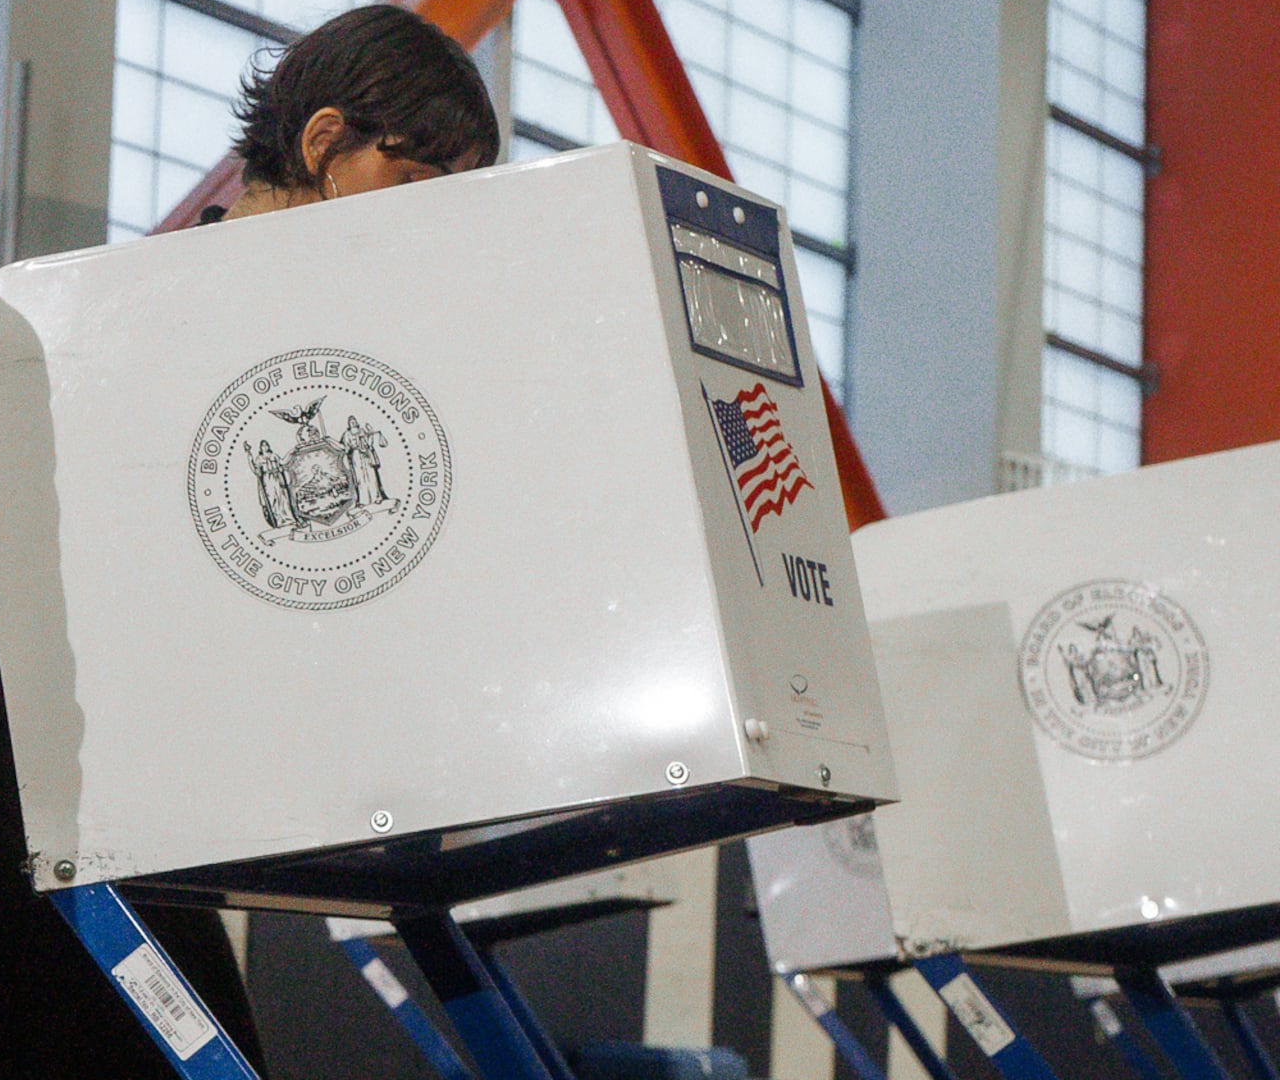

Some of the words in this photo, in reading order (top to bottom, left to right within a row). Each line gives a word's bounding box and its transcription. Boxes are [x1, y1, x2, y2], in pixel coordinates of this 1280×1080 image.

[200, 393, 251, 475] BOARD
[253, 367, 283, 395] OF
[292, 360, 420, 425] ELECTIONS
[204, 505, 228, 533] IN
[221, 533, 264, 578] THE
[267, 571, 328, 597] CITY
[334, 569, 366, 594] OF
[371, 525, 420, 579] NEW
[412, 451, 439, 520] YORK
[304, 519, 361, 541] EXCELSIOR
[781, 552, 834, 607] VOTE
